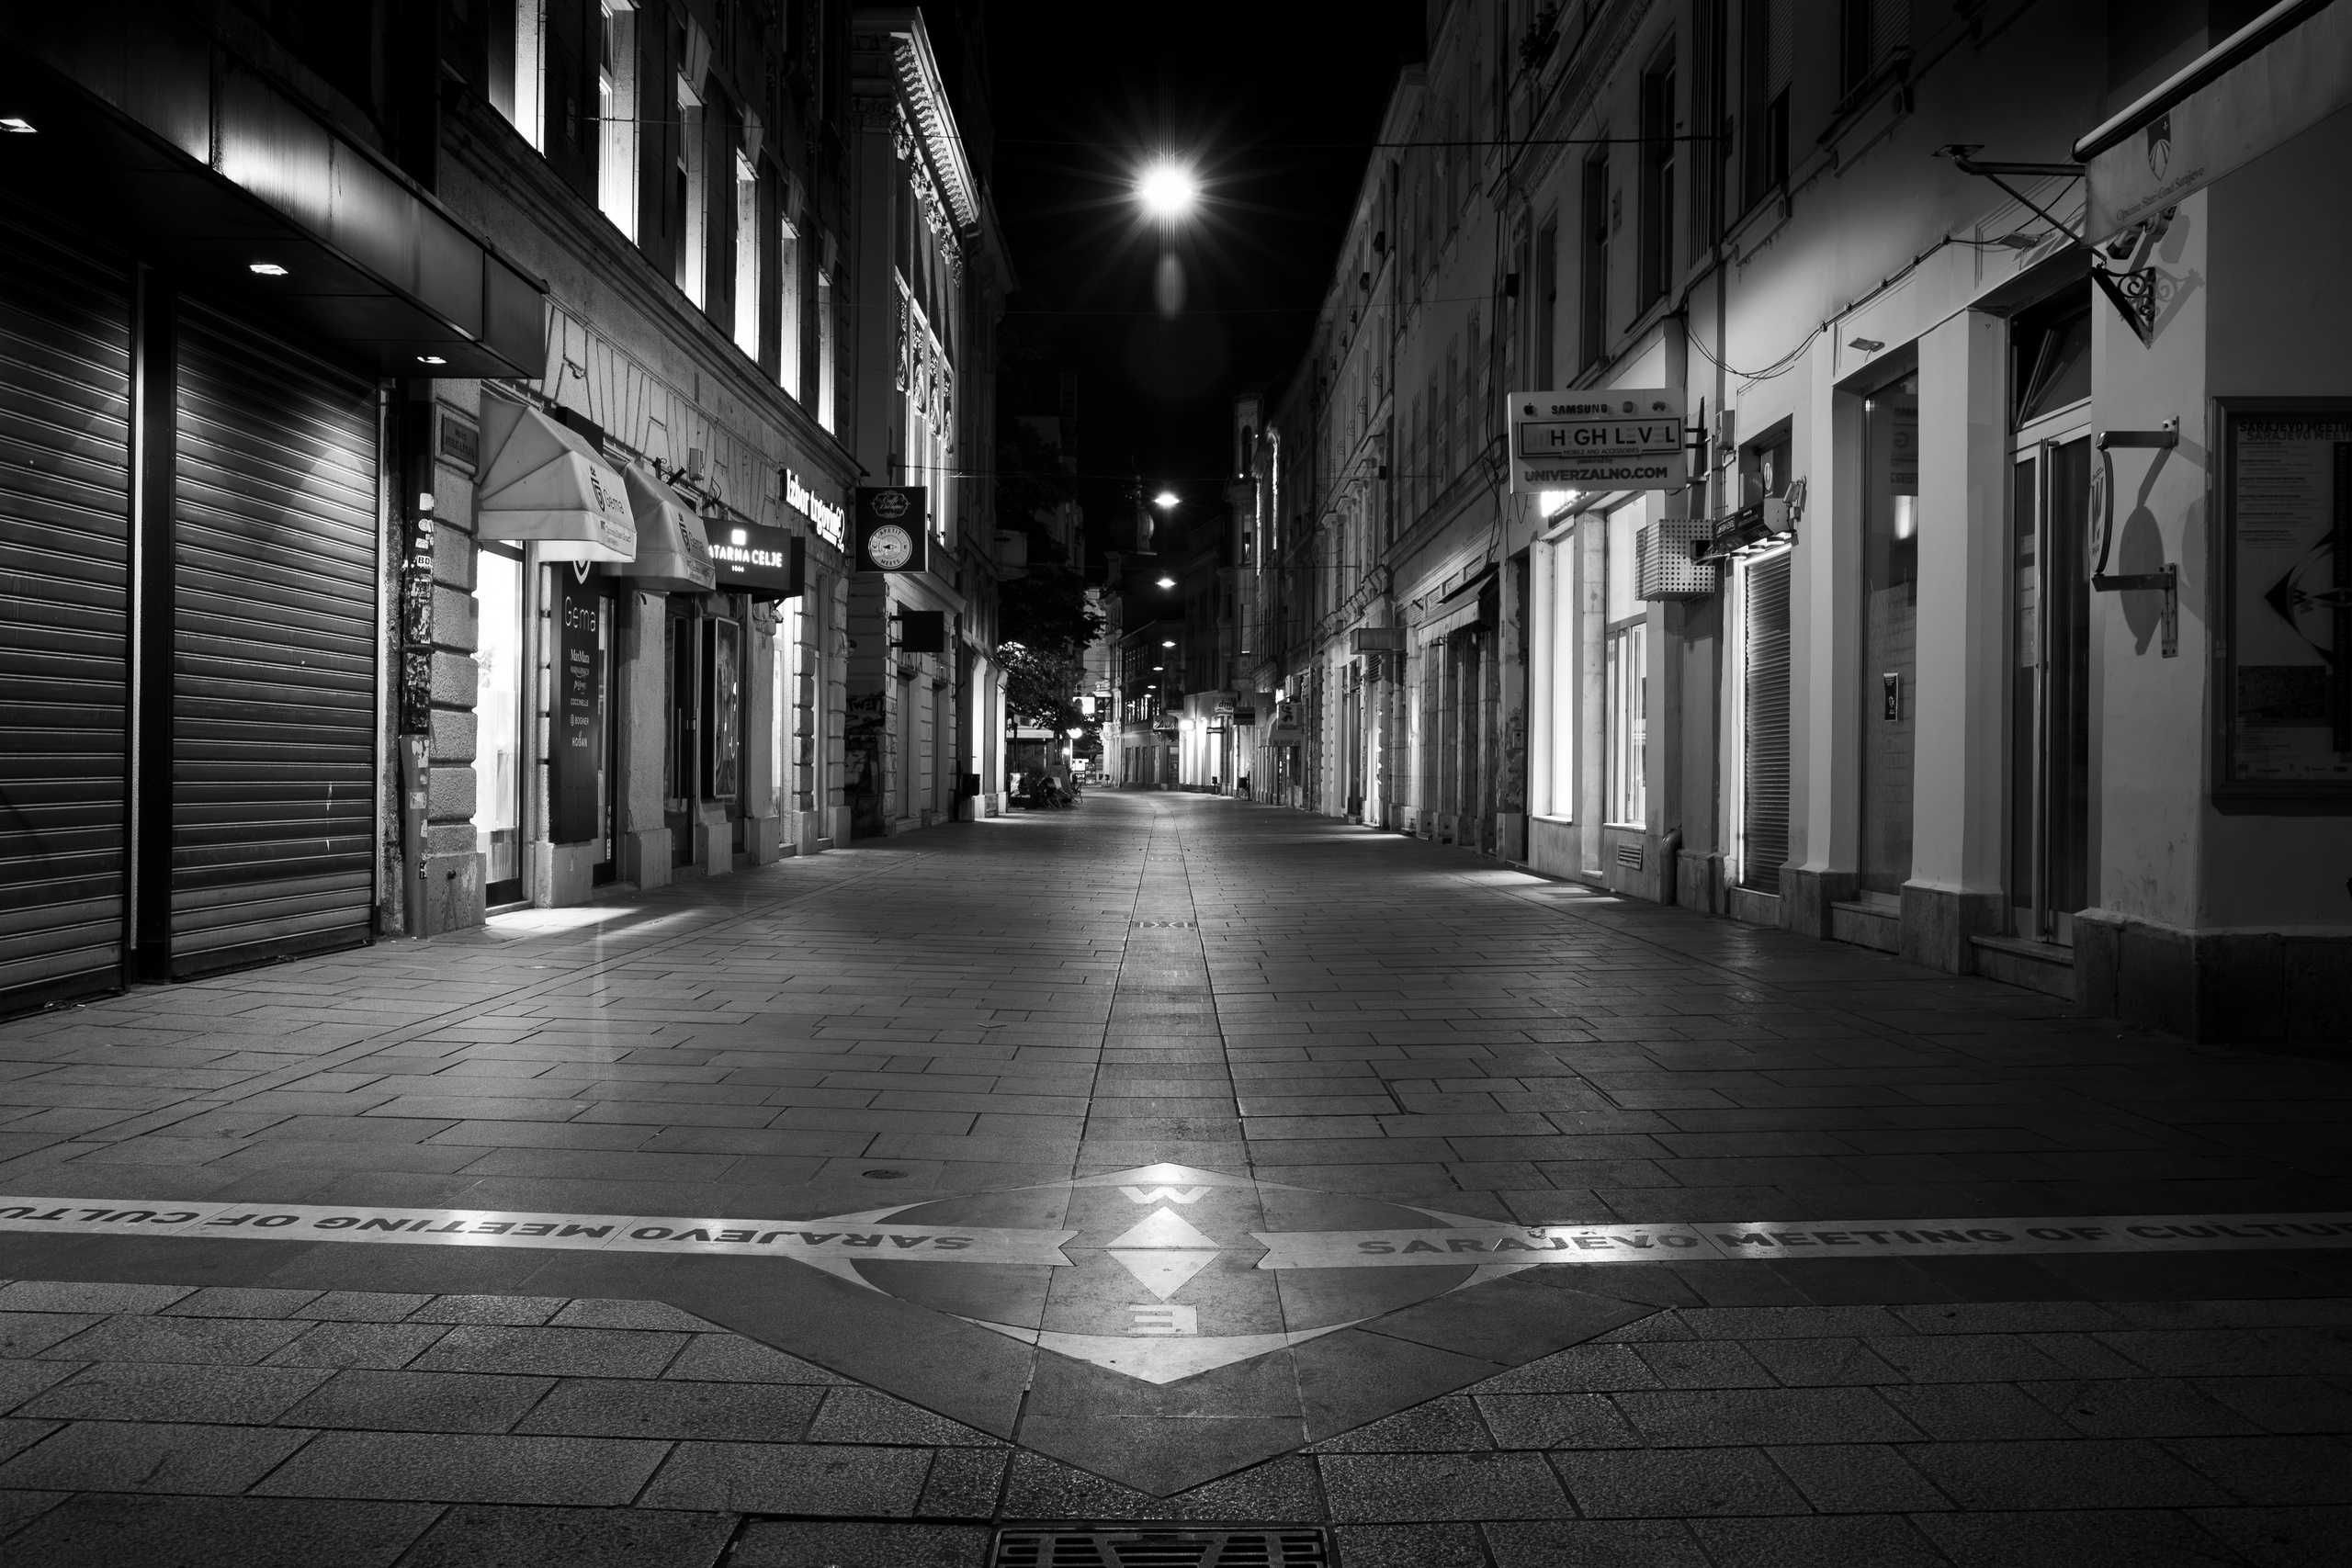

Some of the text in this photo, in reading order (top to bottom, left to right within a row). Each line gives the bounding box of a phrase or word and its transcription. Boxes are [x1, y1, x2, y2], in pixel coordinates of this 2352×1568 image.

[2141, 190, 2157, 209] Stari
[2157, 182, 2175, 199] Grad
[2175, 166, 2205, 191] Sarajevo
[1551, 403, 1608, 415] SAMSUNG
[1551, 425, 1676, 446] HIGH LEVEL
[2239, 421, 2304, 433] SARAJEVO
[1525, 467, 1668, 482] UNIVERZALNO.COM
[786, 468, 810, 516] Izbor
[603, 489, 625, 514] Gema
[688, 531, 705, 553] Gema
[752, 549, 783, 568] CELJE
[880, 558, 900, 567] MEETS
[564, 595, 596, 632] Gema
[570, 649, 590, 663] MaxMara
[570, 698, 589, 707] COCCINELLE
[1218, 700, 1233, 708] dm
[574, 716, 589, 726] BOGNER
[571, 737, 588, 748] HOGAN
[201, 1213, 301, 1228] OF
[313, 1215, 616, 1238] MEETING
[629, 1225, 976, 1250] SARAJEVO
[1357, 1234, 1700, 1255] SARAJEVO
[1714, 1228, 2015, 1248] MEETING
[2024, 1226, 2116, 1242] OF
